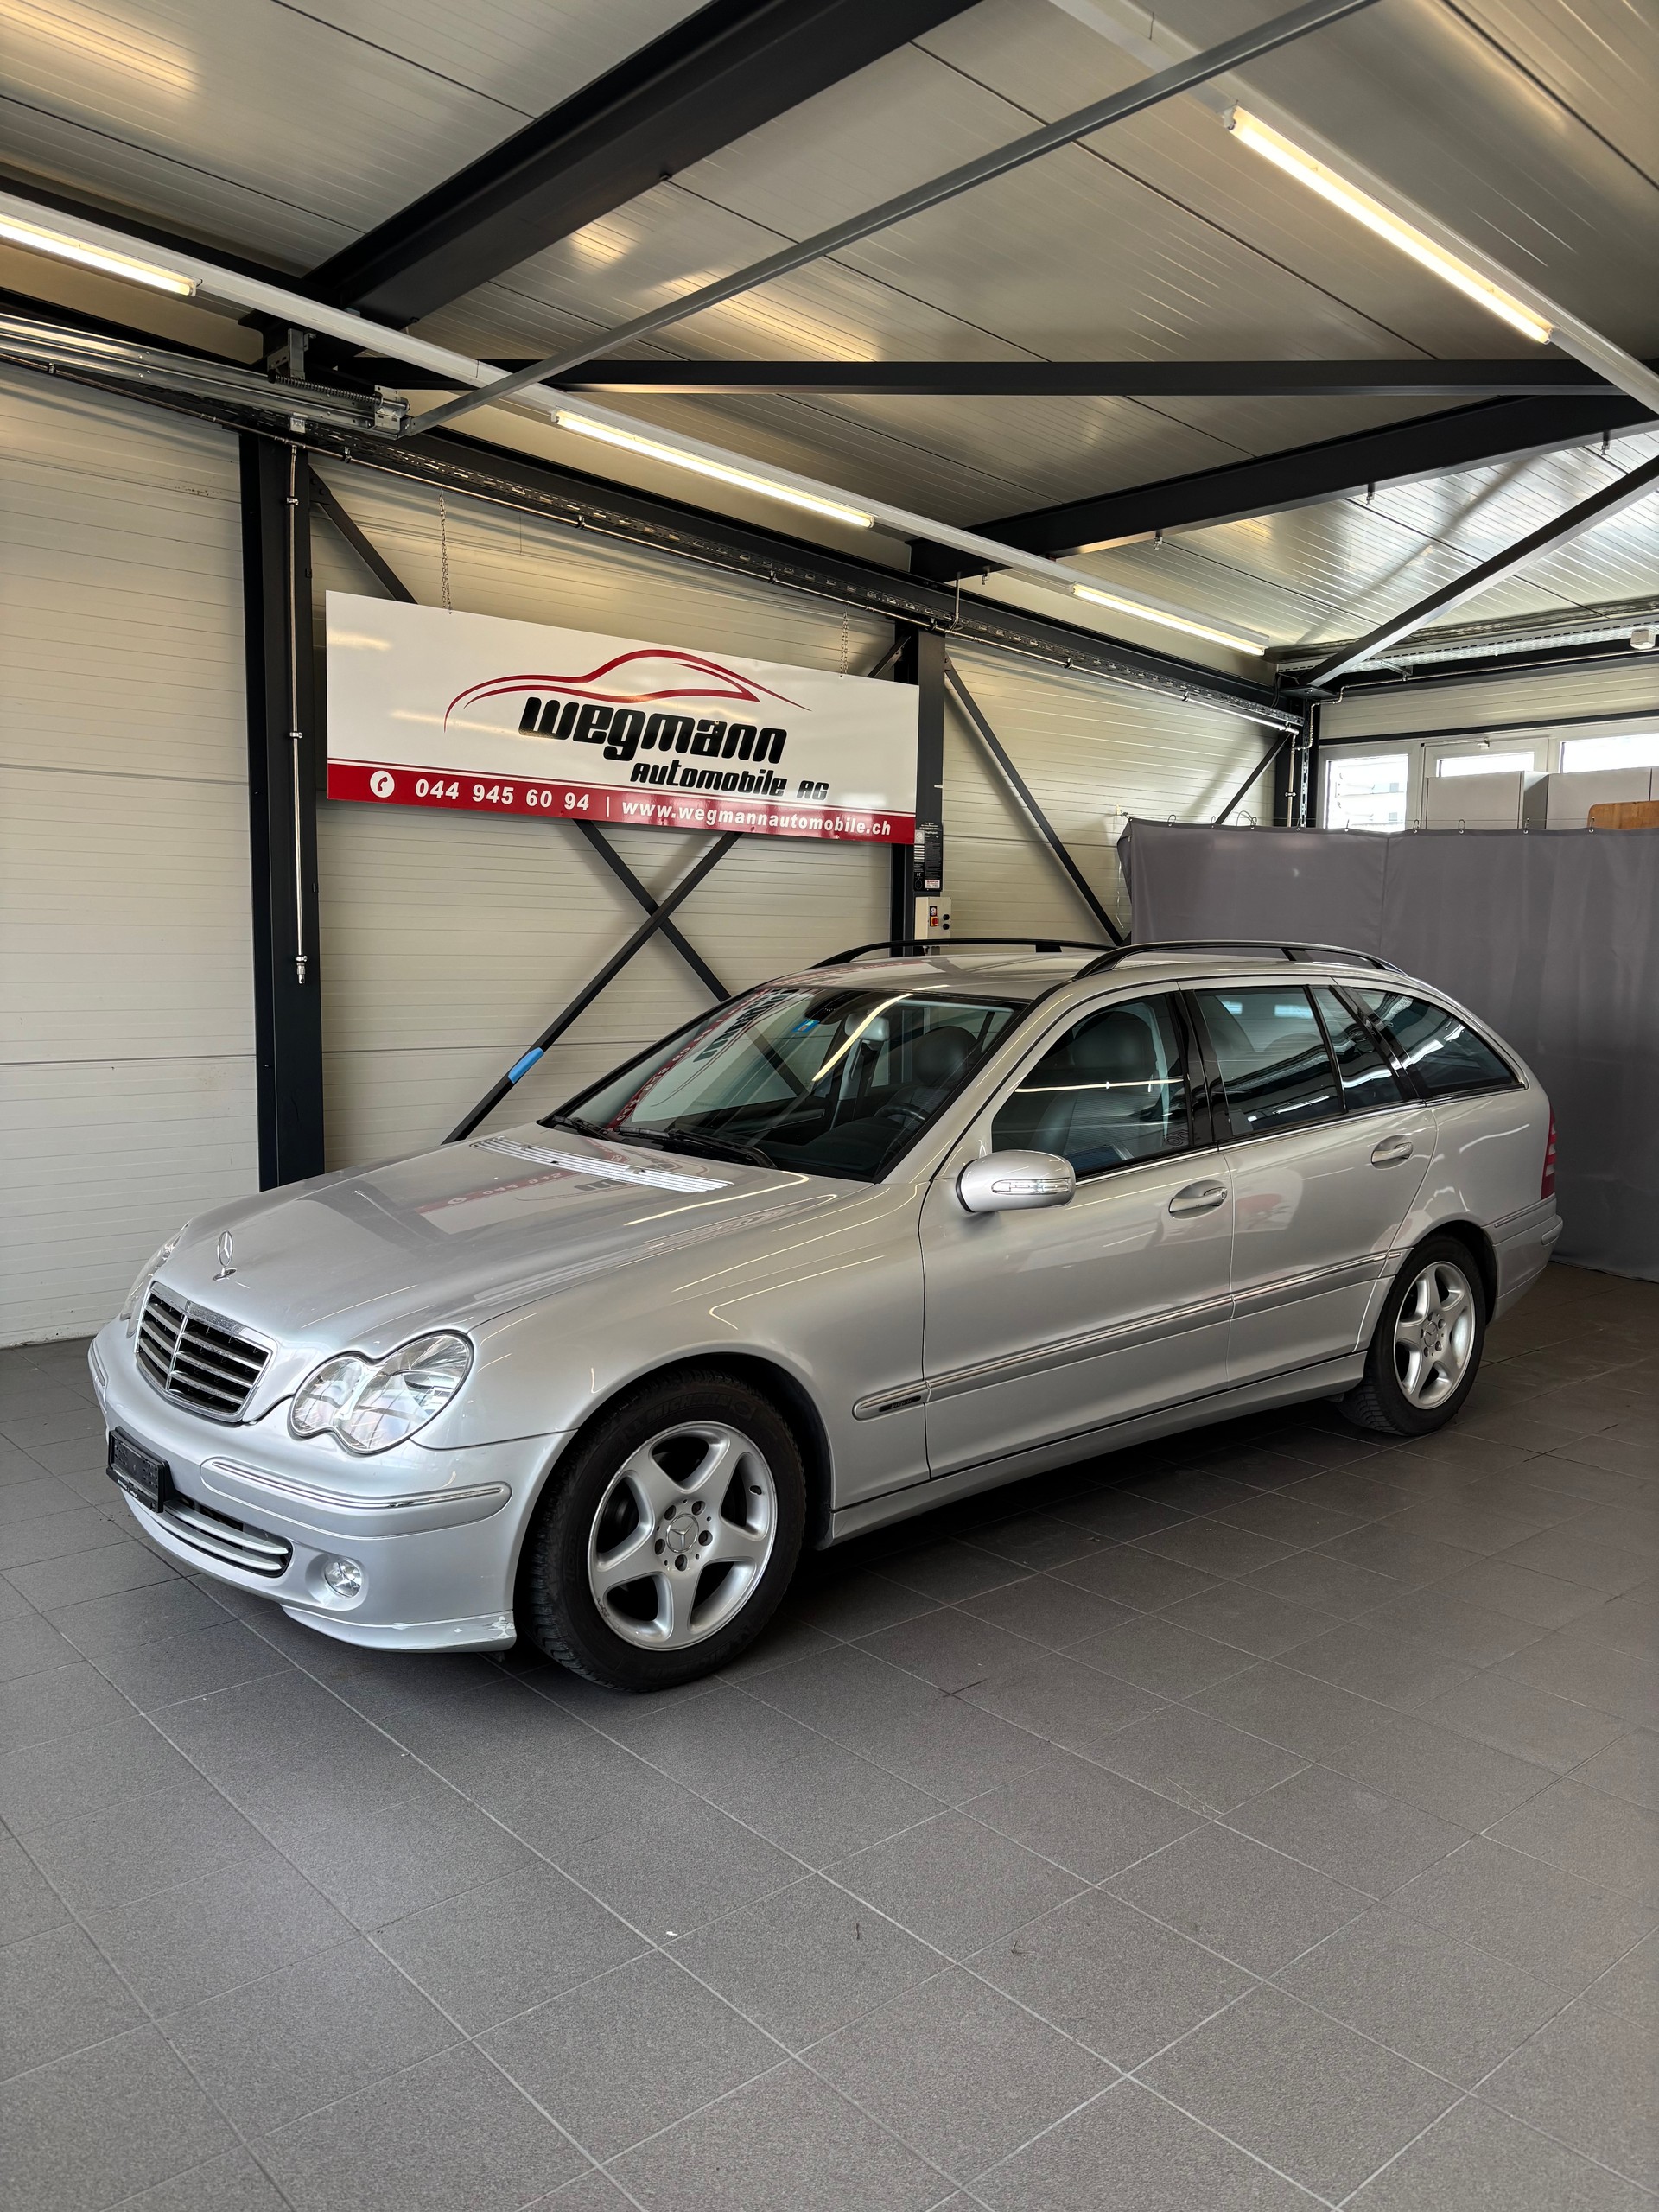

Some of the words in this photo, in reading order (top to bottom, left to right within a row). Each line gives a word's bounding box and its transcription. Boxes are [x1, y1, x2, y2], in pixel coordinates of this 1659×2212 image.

[518, 696, 787, 764] wegmann
[415, 779, 460, 800] 044
[472, 784, 514, 804] 945
[525, 789, 553, 808] 60
[563, 792, 590, 811] 94
[622, 800, 892, 836] www.wegmannautomobile.ch
[796, 779, 830, 801] AG
